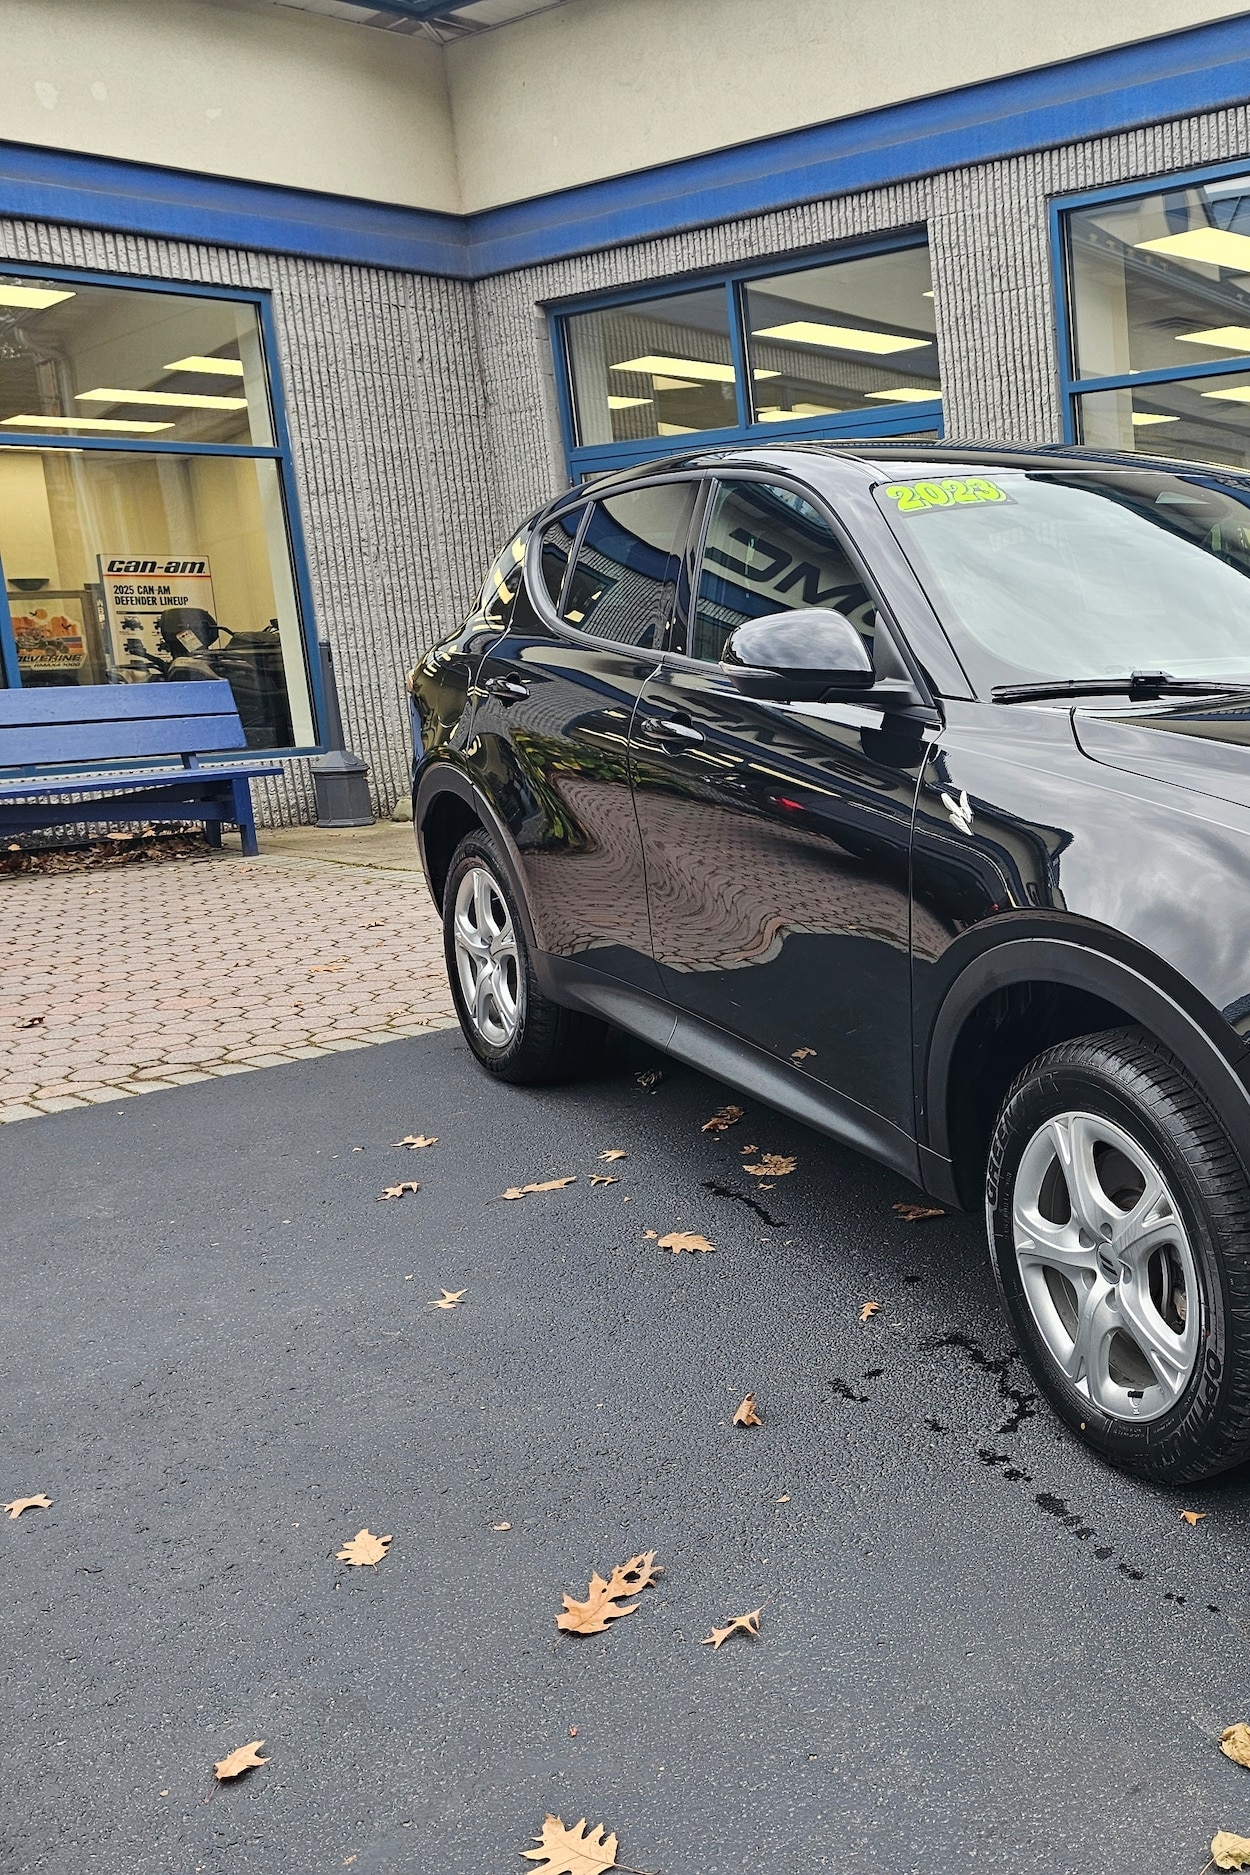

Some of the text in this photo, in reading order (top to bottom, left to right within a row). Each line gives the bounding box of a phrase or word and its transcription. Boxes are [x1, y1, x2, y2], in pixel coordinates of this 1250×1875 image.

[885, 478, 1007, 512] 2023
[107, 560, 206, 574] can-am
[113, 585, 171, 595] 2025 CAN-AM
[115, 596, 189, 606] DEFENDER LINEUP
